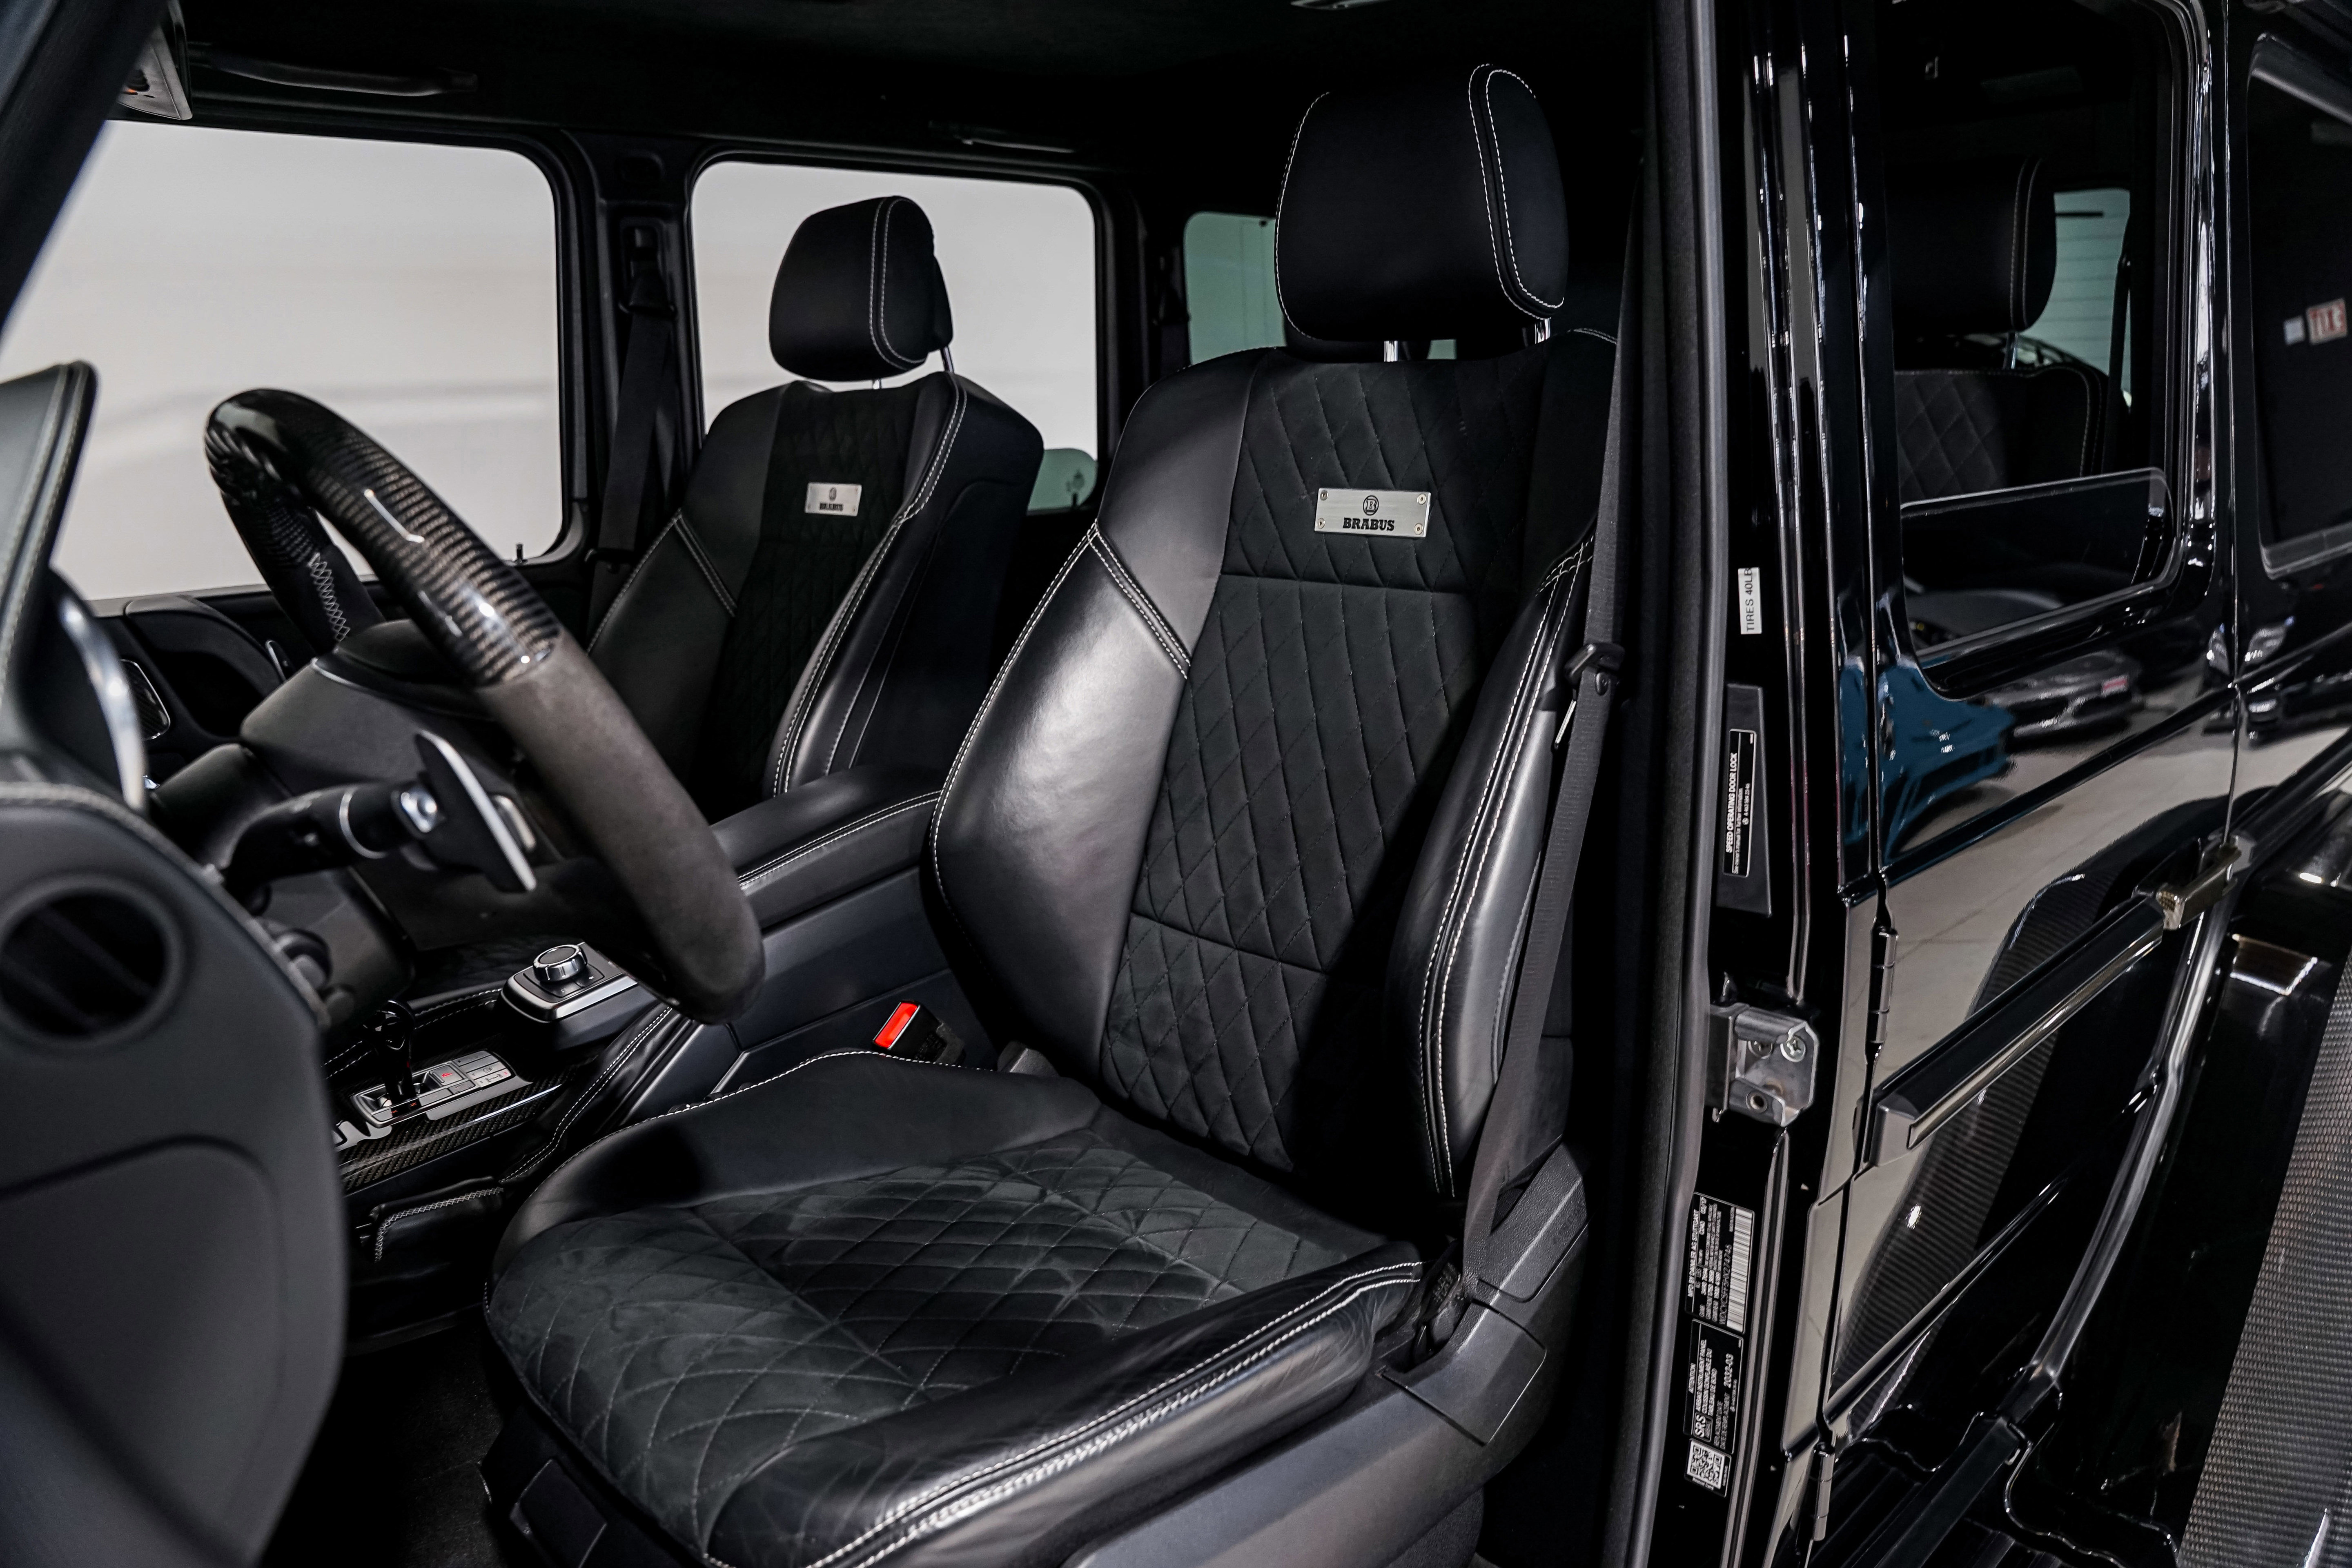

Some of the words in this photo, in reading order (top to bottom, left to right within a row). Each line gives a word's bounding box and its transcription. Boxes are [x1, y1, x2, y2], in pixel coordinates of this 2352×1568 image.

[1343, 517, 1394, 531] BRABUS
[1745, 599, 1754, 632] TIRES
[1729, 752, 1737, 772] LOCK
[1728, 772, 1737, 793] DOOR
[1726, 793, 1735, 831] OPERATING
[1726, 831, 1734, 853] SPEED
[1723, 1353, 1734, 1388] 2032-03
[1695, 1412, 1707, 1438] SRS
